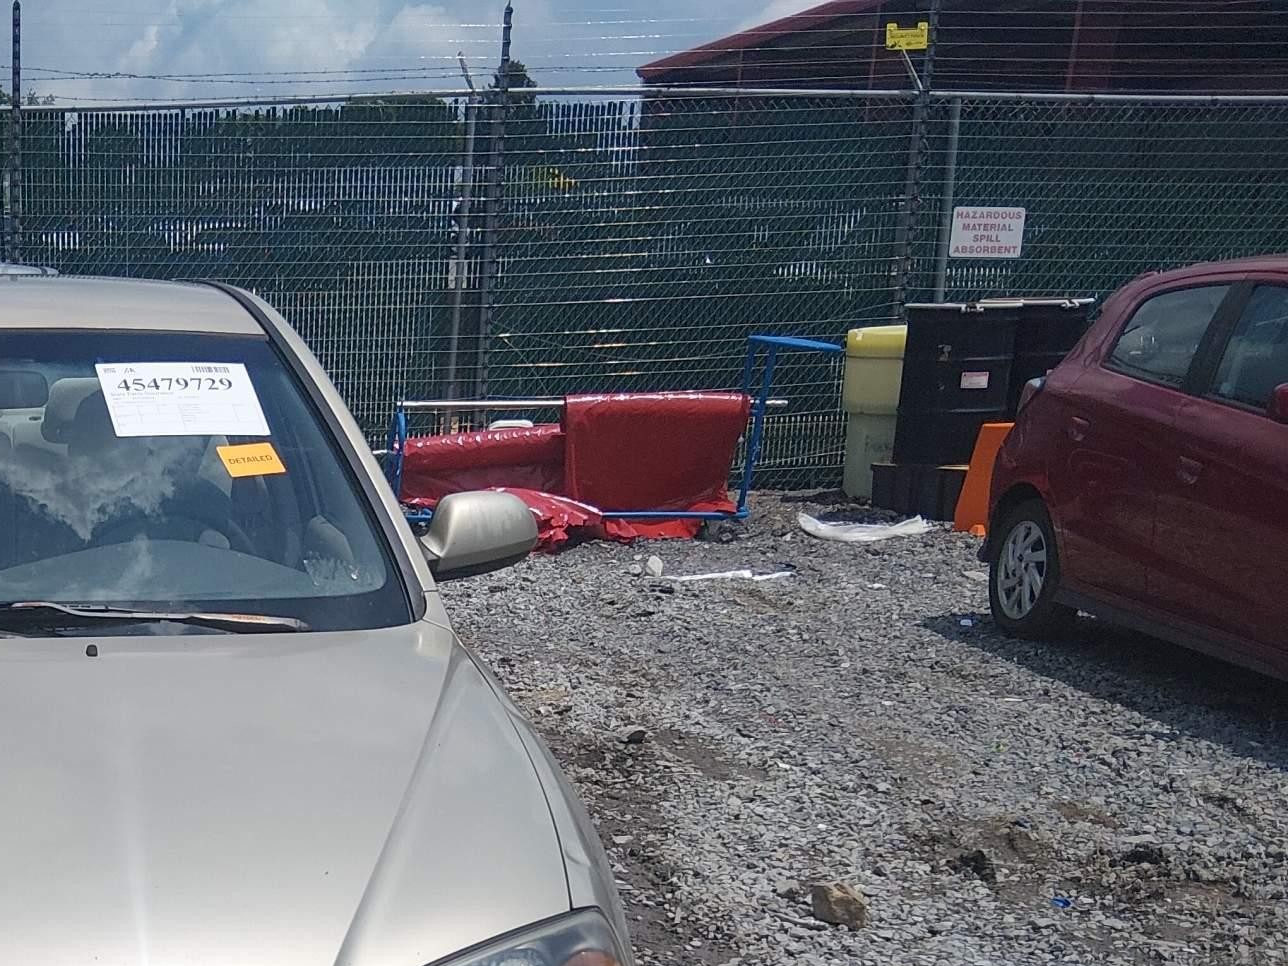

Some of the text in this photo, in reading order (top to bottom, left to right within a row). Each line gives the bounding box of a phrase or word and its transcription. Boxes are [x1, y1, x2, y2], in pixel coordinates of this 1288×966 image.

[956, 211, 1022, 220] HAZARDOUS
[962, 223, 1014, 231] MATERIAL
[972, 234, 1001, 243] SPILL
[953, 245, 1018, 254] ABSORBENT
[116, 377, 233, 392] 45479729
[228, 454, 273, 466] DETAILED
